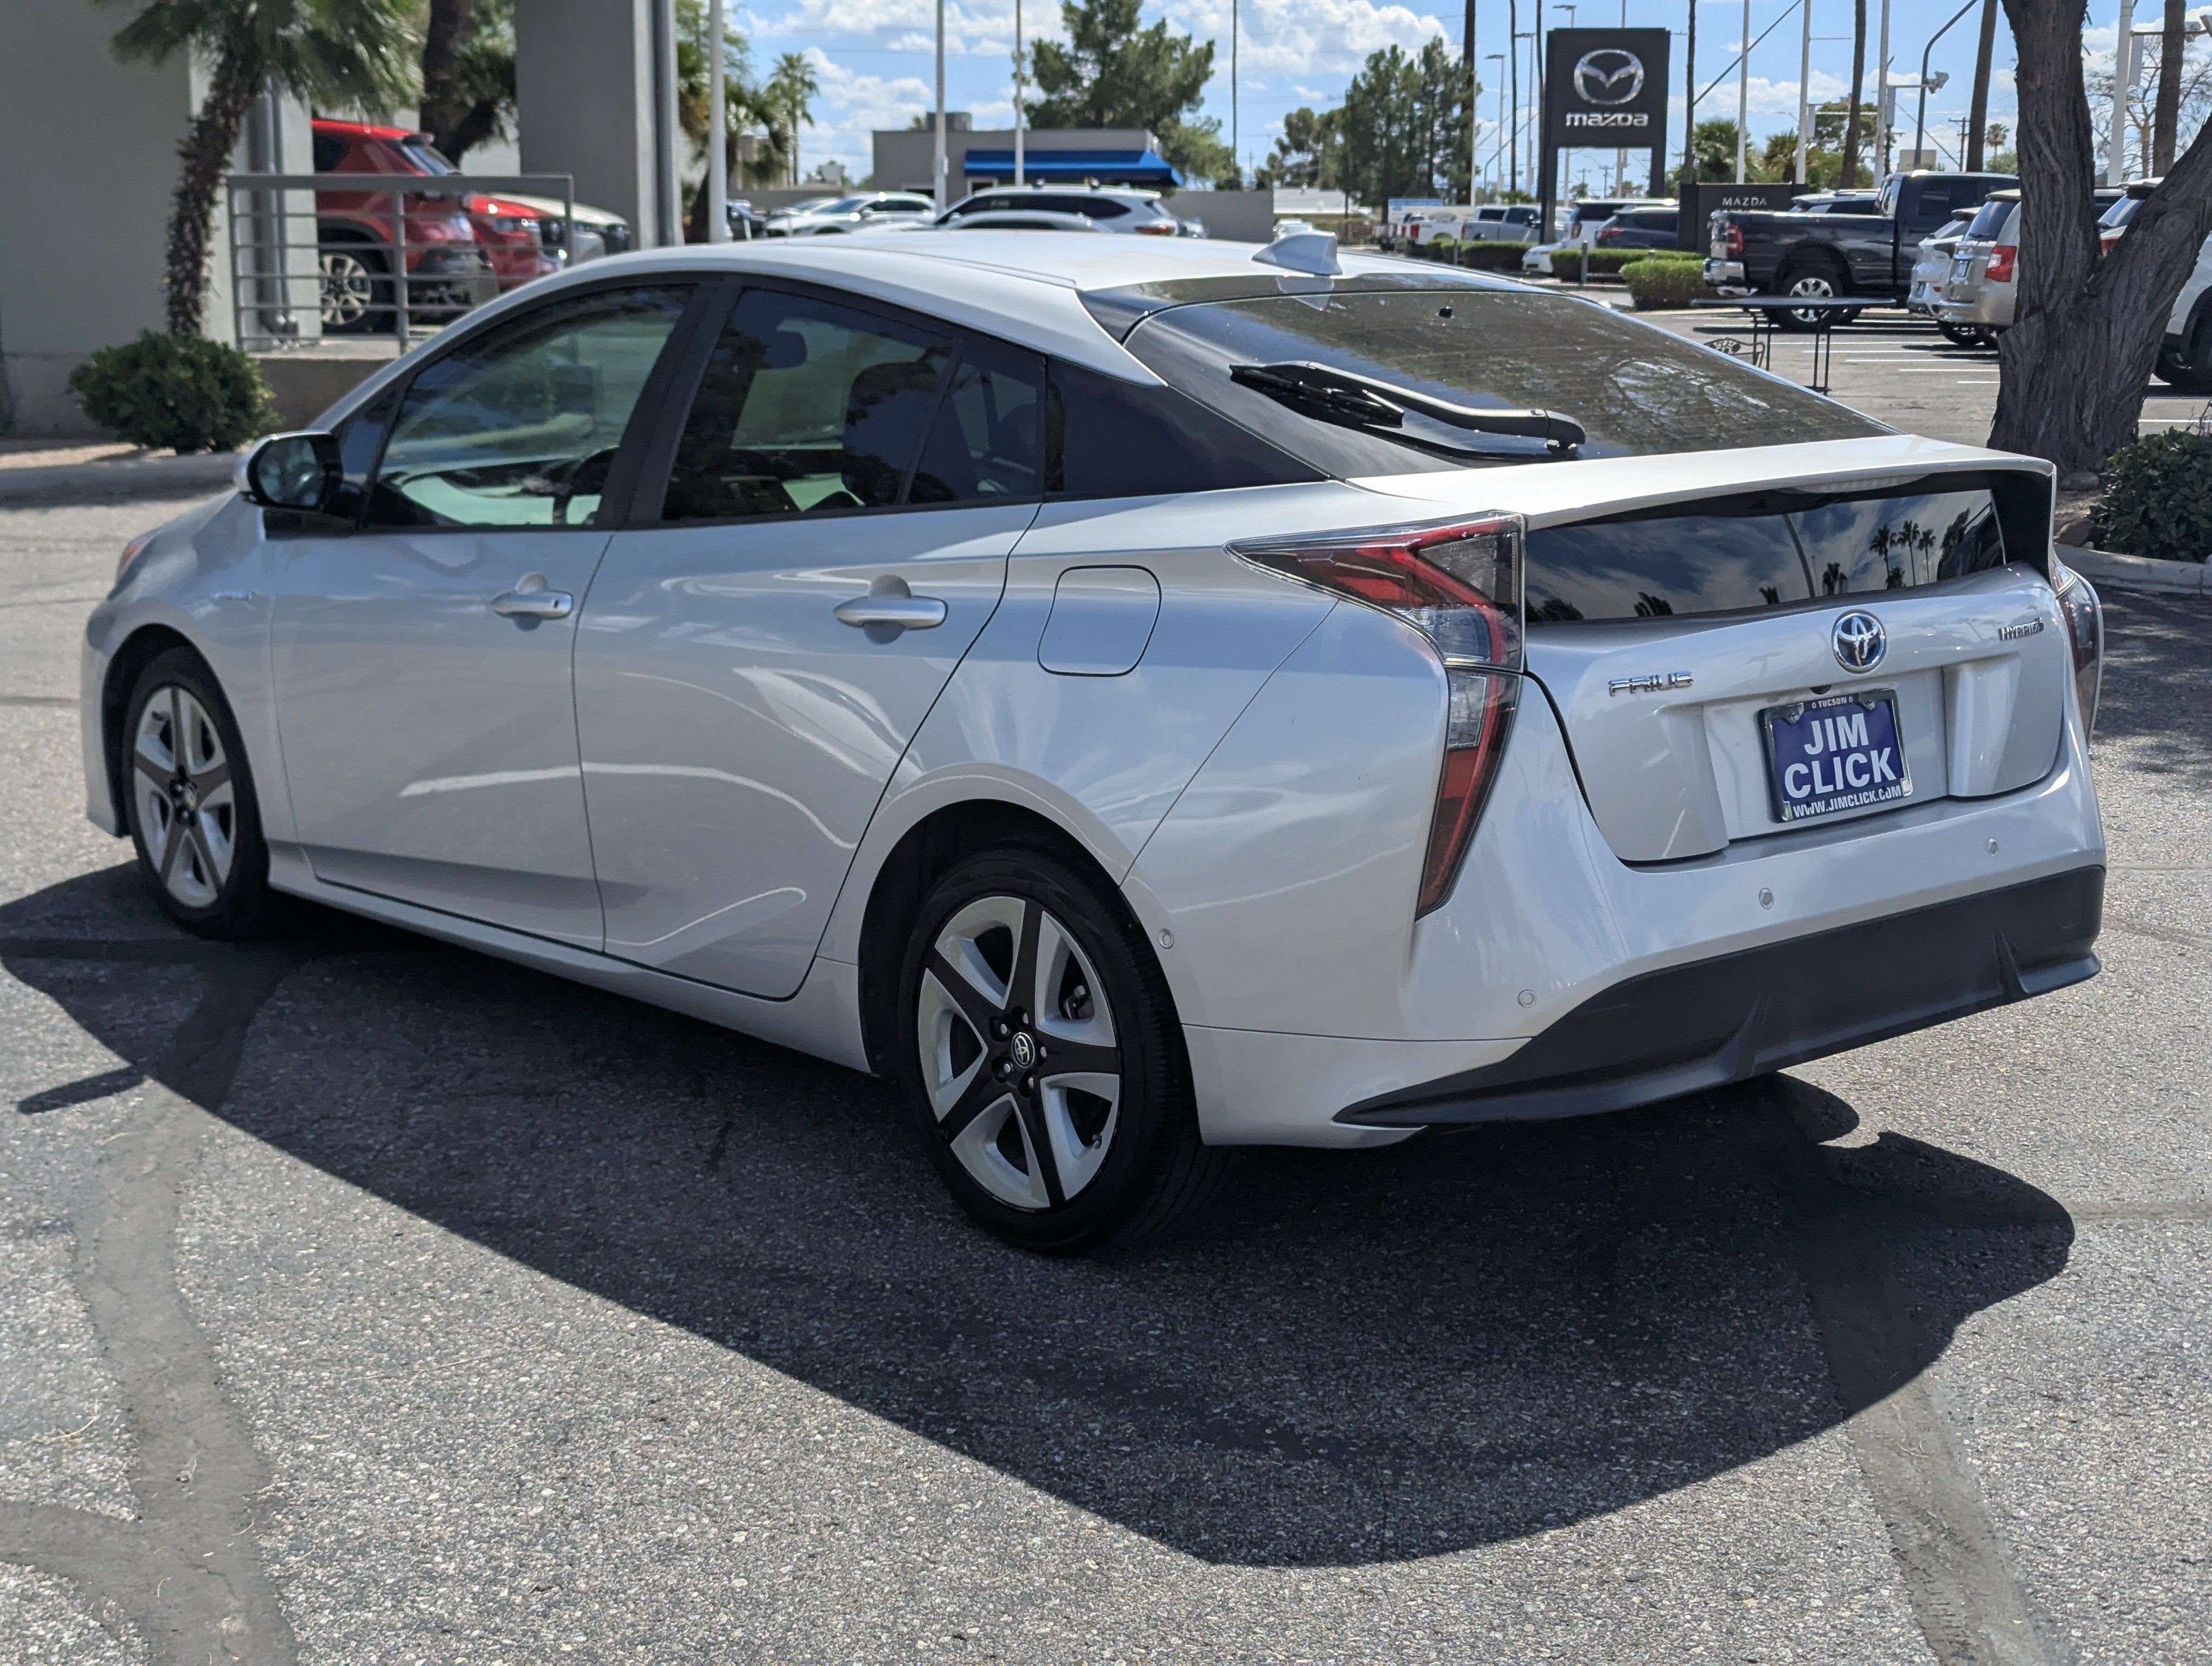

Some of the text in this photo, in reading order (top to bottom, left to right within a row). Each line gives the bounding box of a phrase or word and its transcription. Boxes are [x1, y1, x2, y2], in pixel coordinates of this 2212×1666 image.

[1722, 196, 1767, 206] MAZDA
[1609, 671, 1694, 697] PRIUS
[1818, 696, 1847, 708] TUCSON
[1803, 713, 1869, 755] JIM
[1784, 747, 1896, 798] CLICK
[1793, 785, 1903, 817] WWW.JIMCLICK.COM
